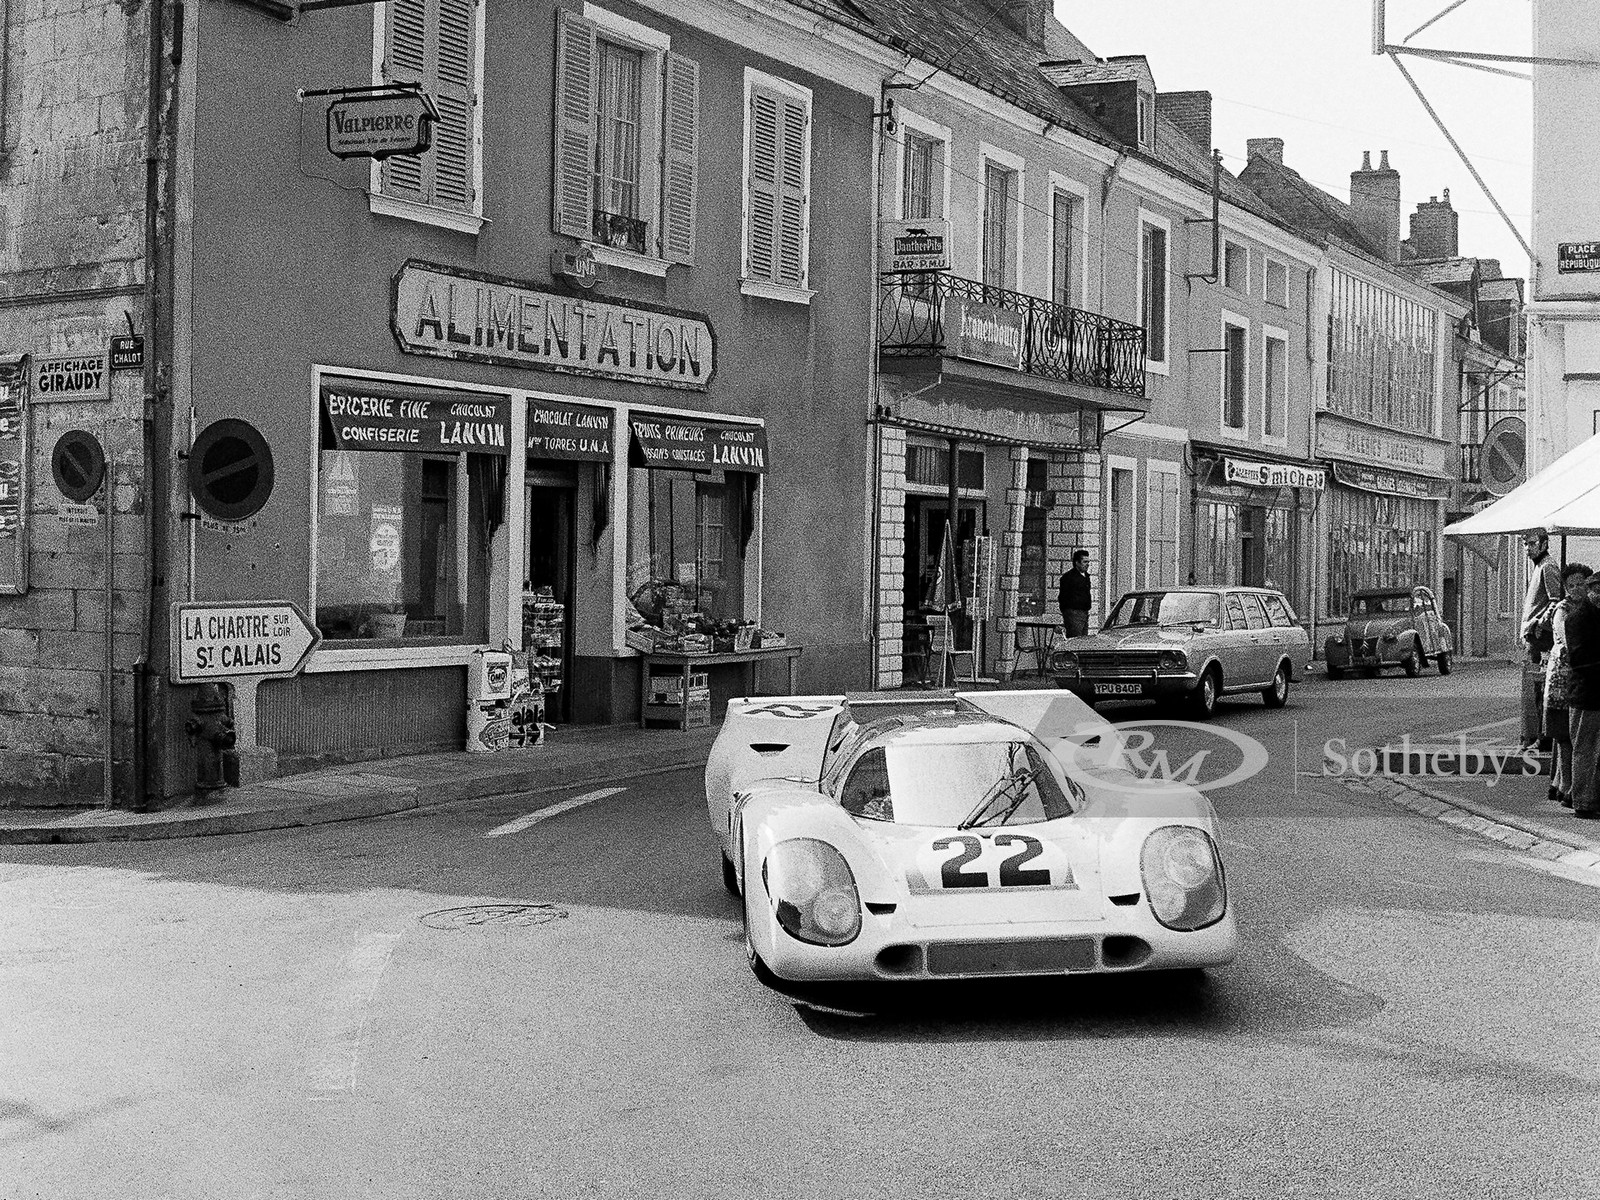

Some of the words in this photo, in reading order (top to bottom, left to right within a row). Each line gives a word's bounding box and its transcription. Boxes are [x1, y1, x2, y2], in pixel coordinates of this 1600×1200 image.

[1568, 245, 1596, 254] PLACE
[415, 282, 701, 376] ALIMENTATION
[120, 340, 134, 350] RUE
[114, 352, 141, 364] CHALOT
[39, 359, 103, 375] AFFICHAGE
[38, 372, 103, 394] GIRAUDY
[399, 400, 430, 420] FINE
[450, 403, 496, 418] CHOCOLAT
[534, 408, 573, 426] CHOCOLAT
[576, 413, 609, 430] LANVIN
[341, 427, 420, 444] CONFISERIE
[439, 421, 505, 447] LANVIN
[665, 425, 706, 442] PRIMEURS
[720, 430, 755, 443] CHOCOLAT
[544, 436, 577, 452] TORRES
[712, 443, 764, 468] LANVIN
[185, 616, 203, 641] LA
[208, 613, 269, 640] CHARTRE
[273, 614, 289, 624] SUR
[273, 626, 291, 638] LOIR
[221, 643, 282, 668] CALAIS
[1096, 684, 1114, 693] YPU
[931, 834, 1051, 889] 22
